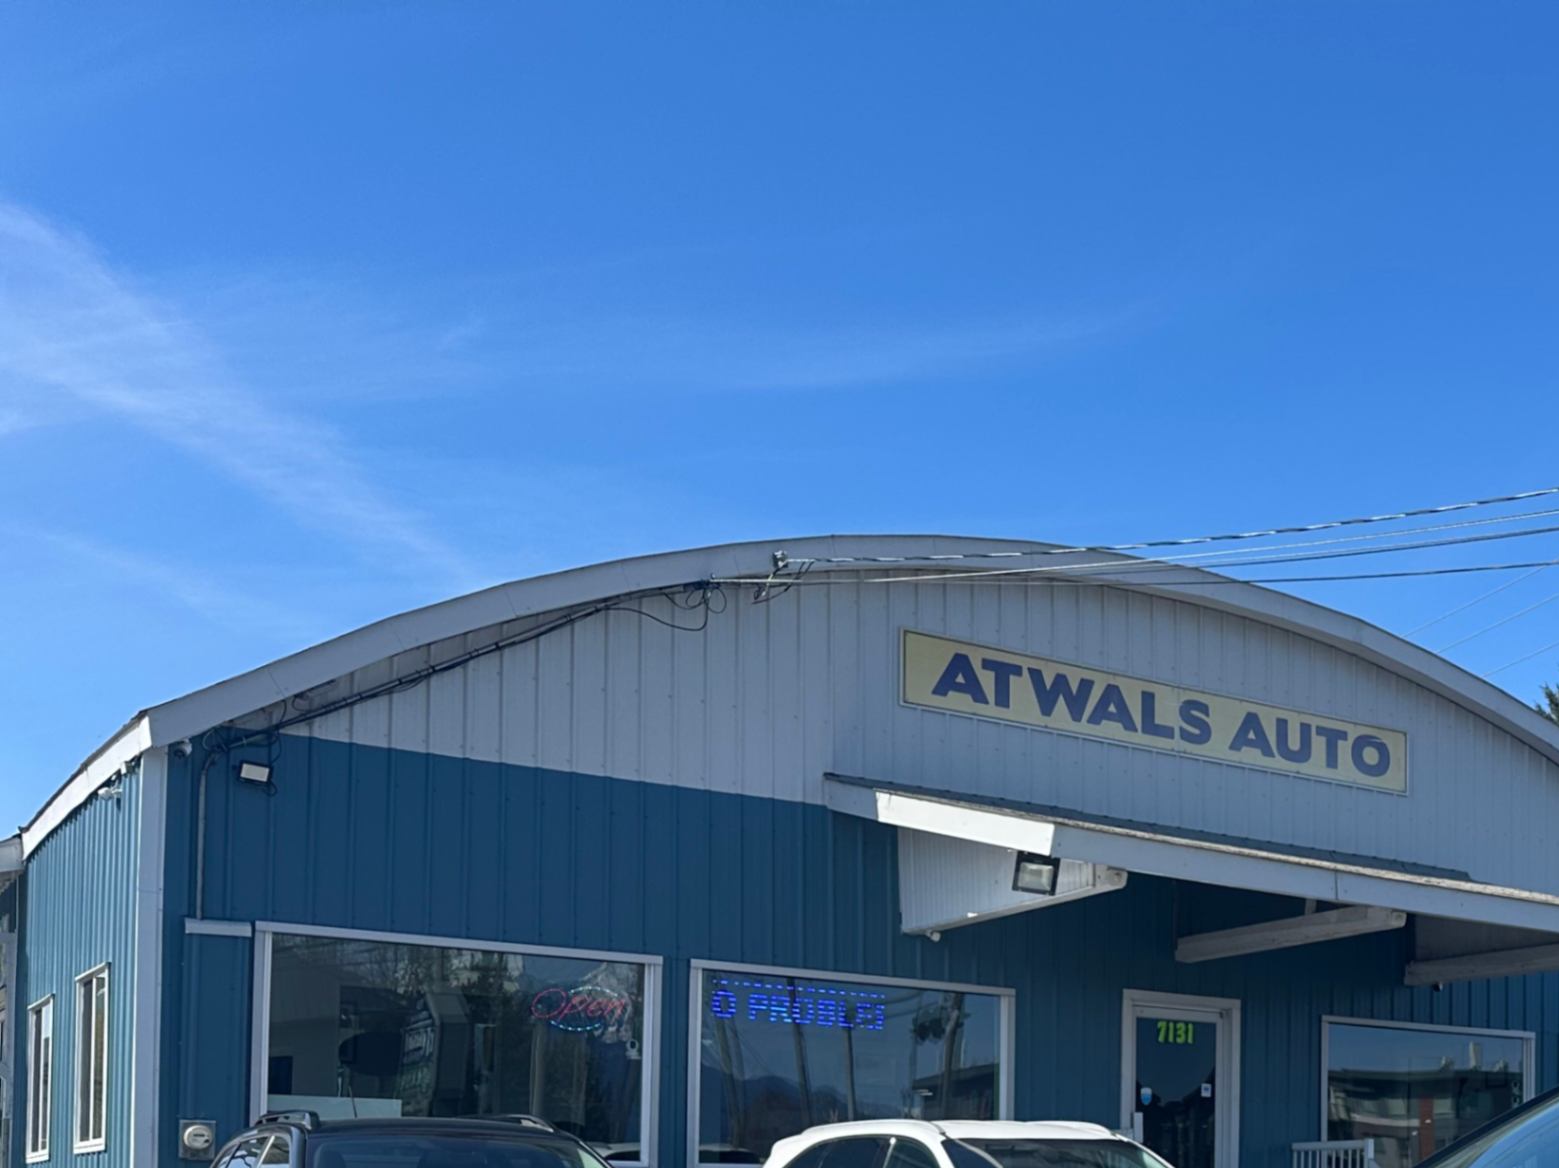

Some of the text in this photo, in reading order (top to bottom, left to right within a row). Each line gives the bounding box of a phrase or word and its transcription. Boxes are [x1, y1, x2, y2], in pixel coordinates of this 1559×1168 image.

[931, 652, 1391, 776] ATWALS AUTO
[1157, 1021, 1194, 1044] 7131
